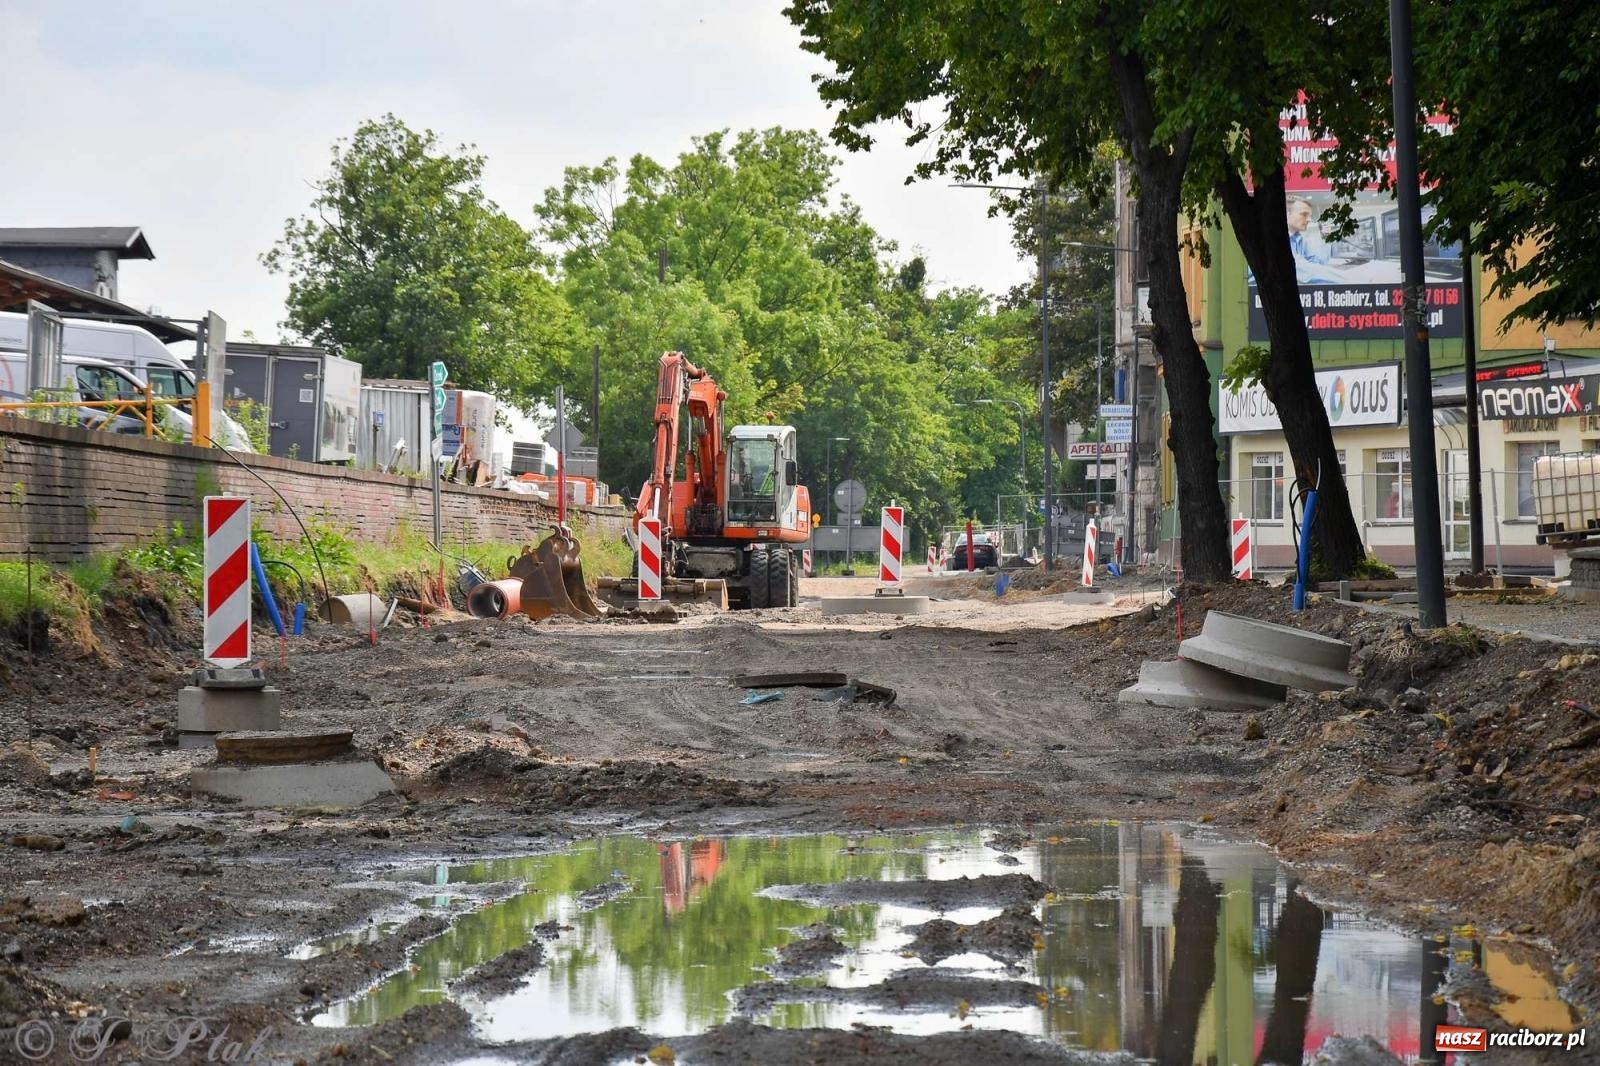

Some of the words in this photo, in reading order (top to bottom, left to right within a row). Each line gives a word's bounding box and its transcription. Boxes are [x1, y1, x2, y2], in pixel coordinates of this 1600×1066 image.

[1327, 289, 1373, 308] Racibórz,
[1375, 289, 1391, 307] tel.
[1226, 391, 1257, 419] KOMIS
[1351, 373, 1388, 414] OLUŚ
[1070, 444, 1113, 455] APTEKA
